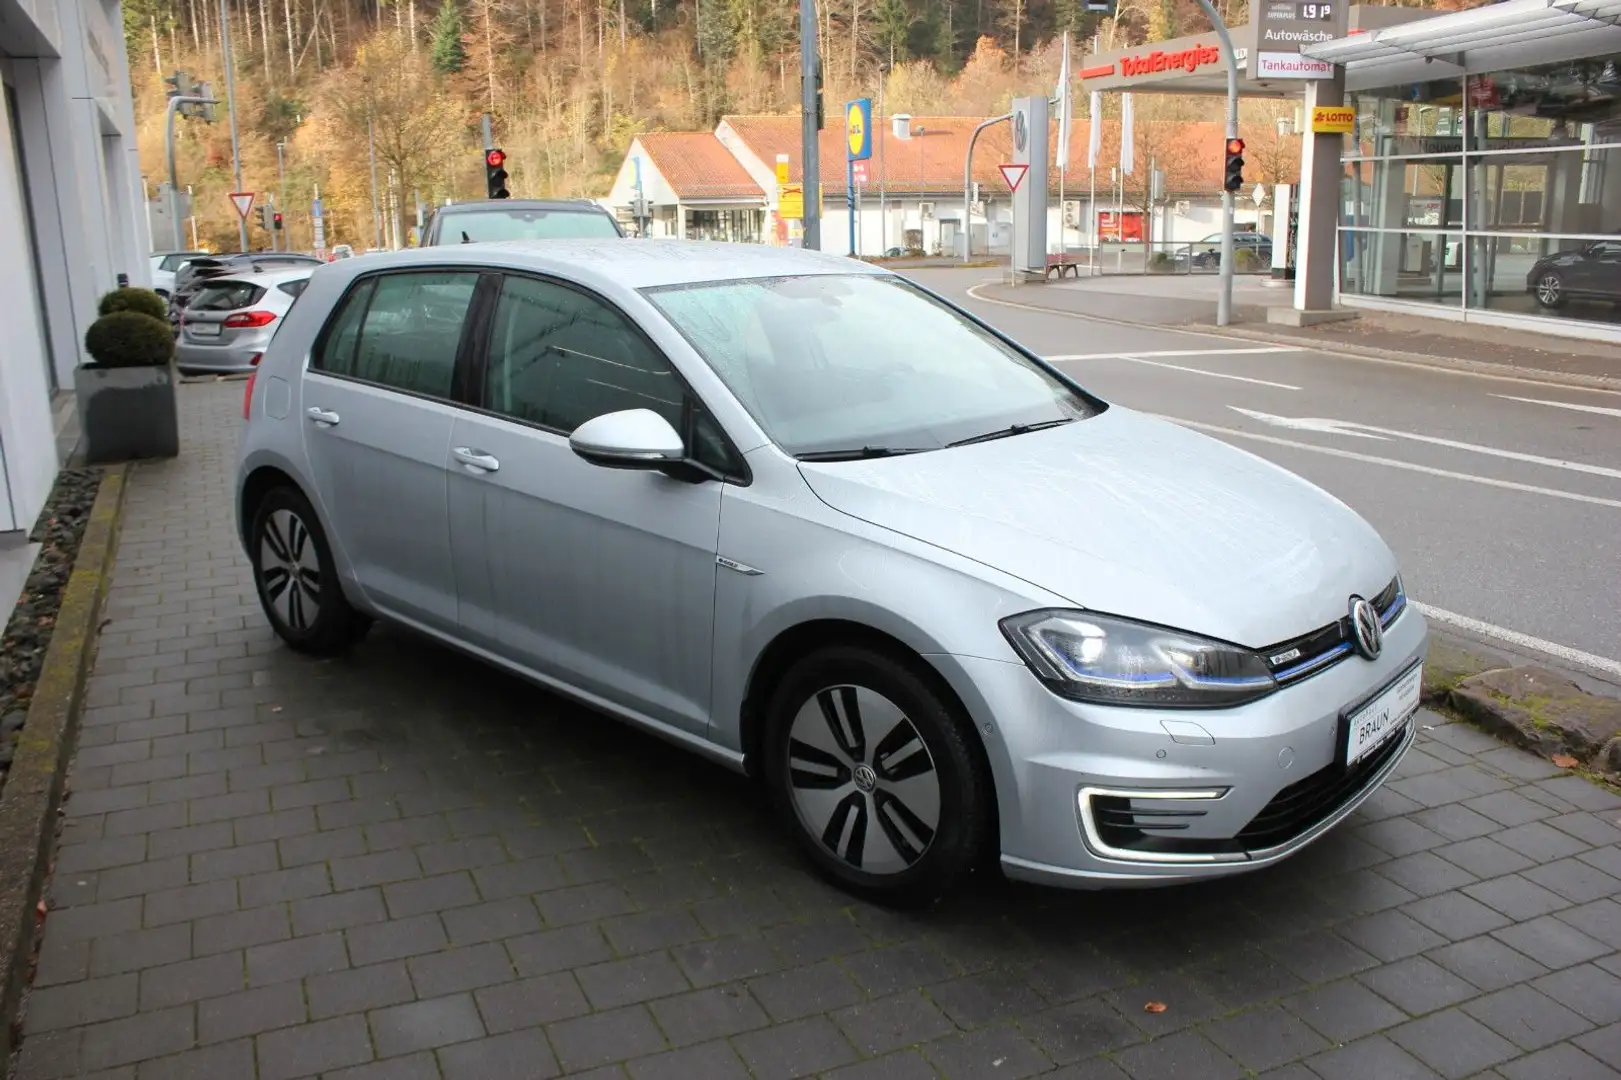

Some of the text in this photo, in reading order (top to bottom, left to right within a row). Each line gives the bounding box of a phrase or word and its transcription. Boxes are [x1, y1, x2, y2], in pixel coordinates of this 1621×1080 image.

[1264, 28, 1333, 41] Autowäsche
[1120, 43, 1219, 77] TotalEnergies
[1262, 60, 1331, 73] Tankautomat
[1327, 112, 1353, 122] LOTTO
[1359, 707, 1390, 744] BRAUN
